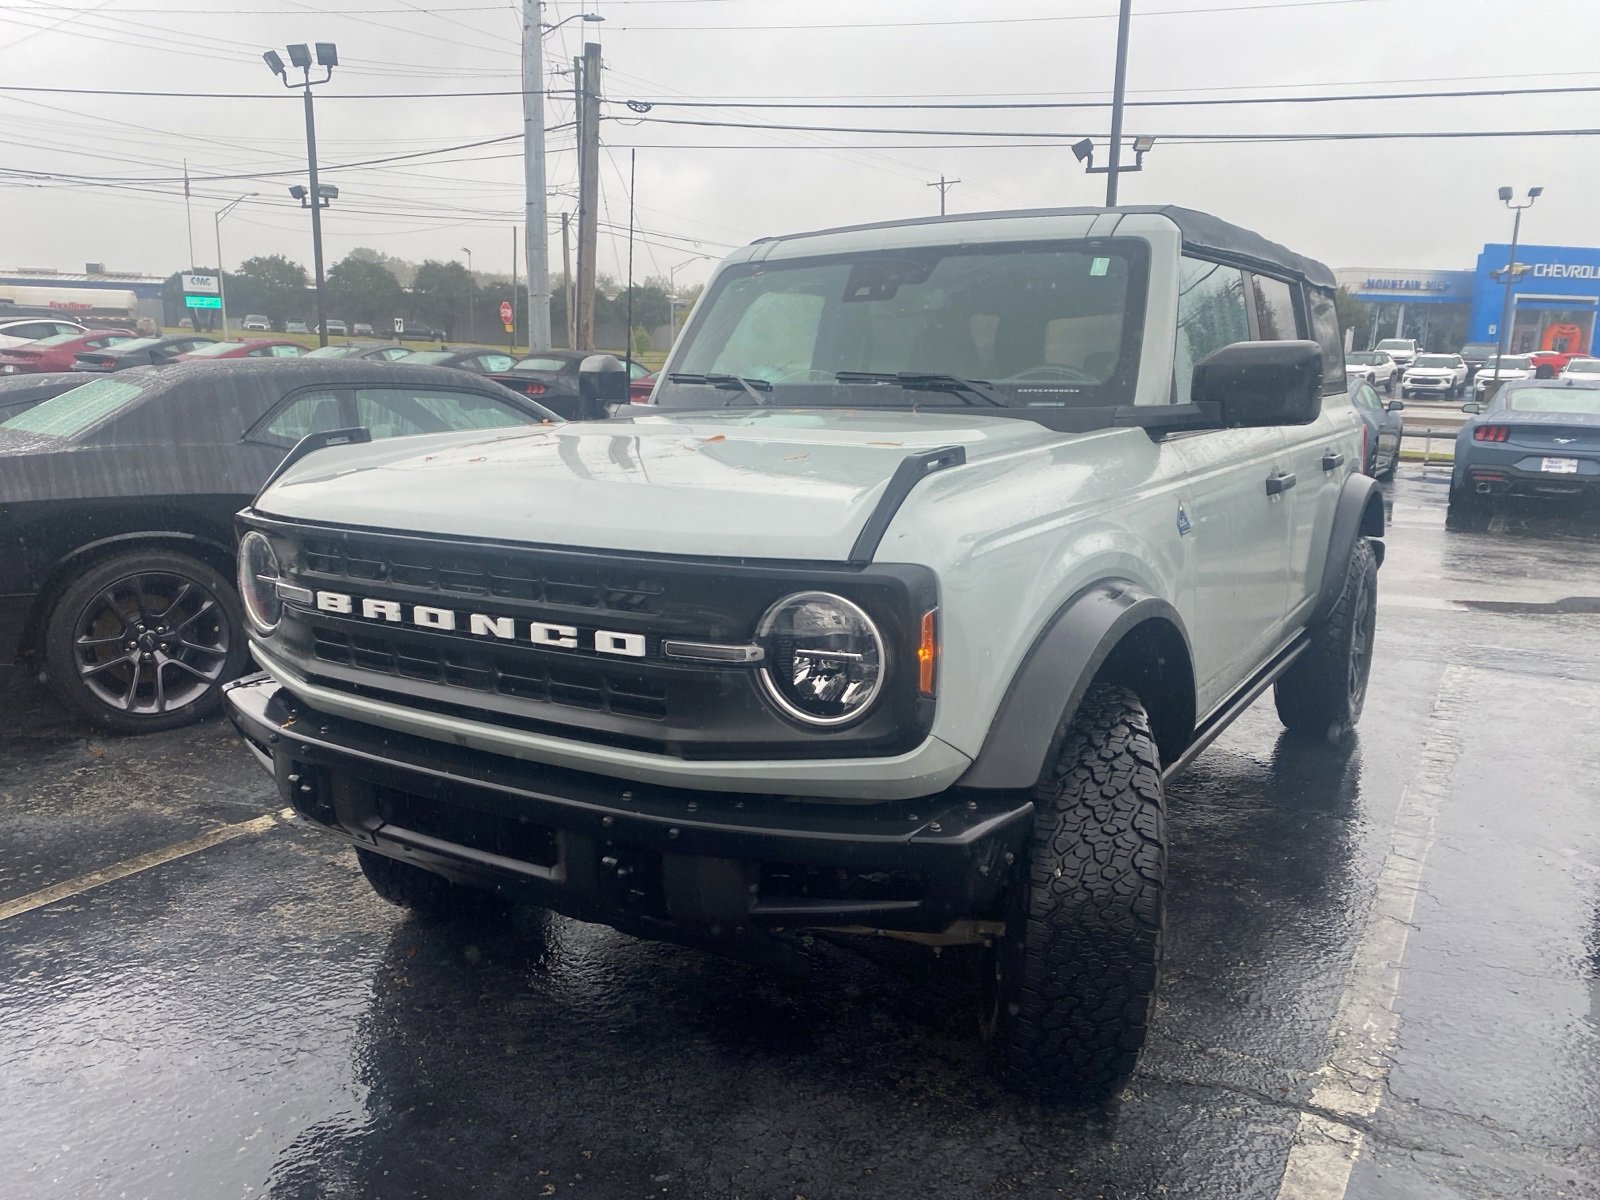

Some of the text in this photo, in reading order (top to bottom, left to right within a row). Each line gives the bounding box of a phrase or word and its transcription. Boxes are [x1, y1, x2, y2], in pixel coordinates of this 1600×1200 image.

[1534, 263, 1600, 279] CHEVROL
[1364, 278, 1422, 290] MOUNTAIN
[316, 590, 647, 658] BRONCO
